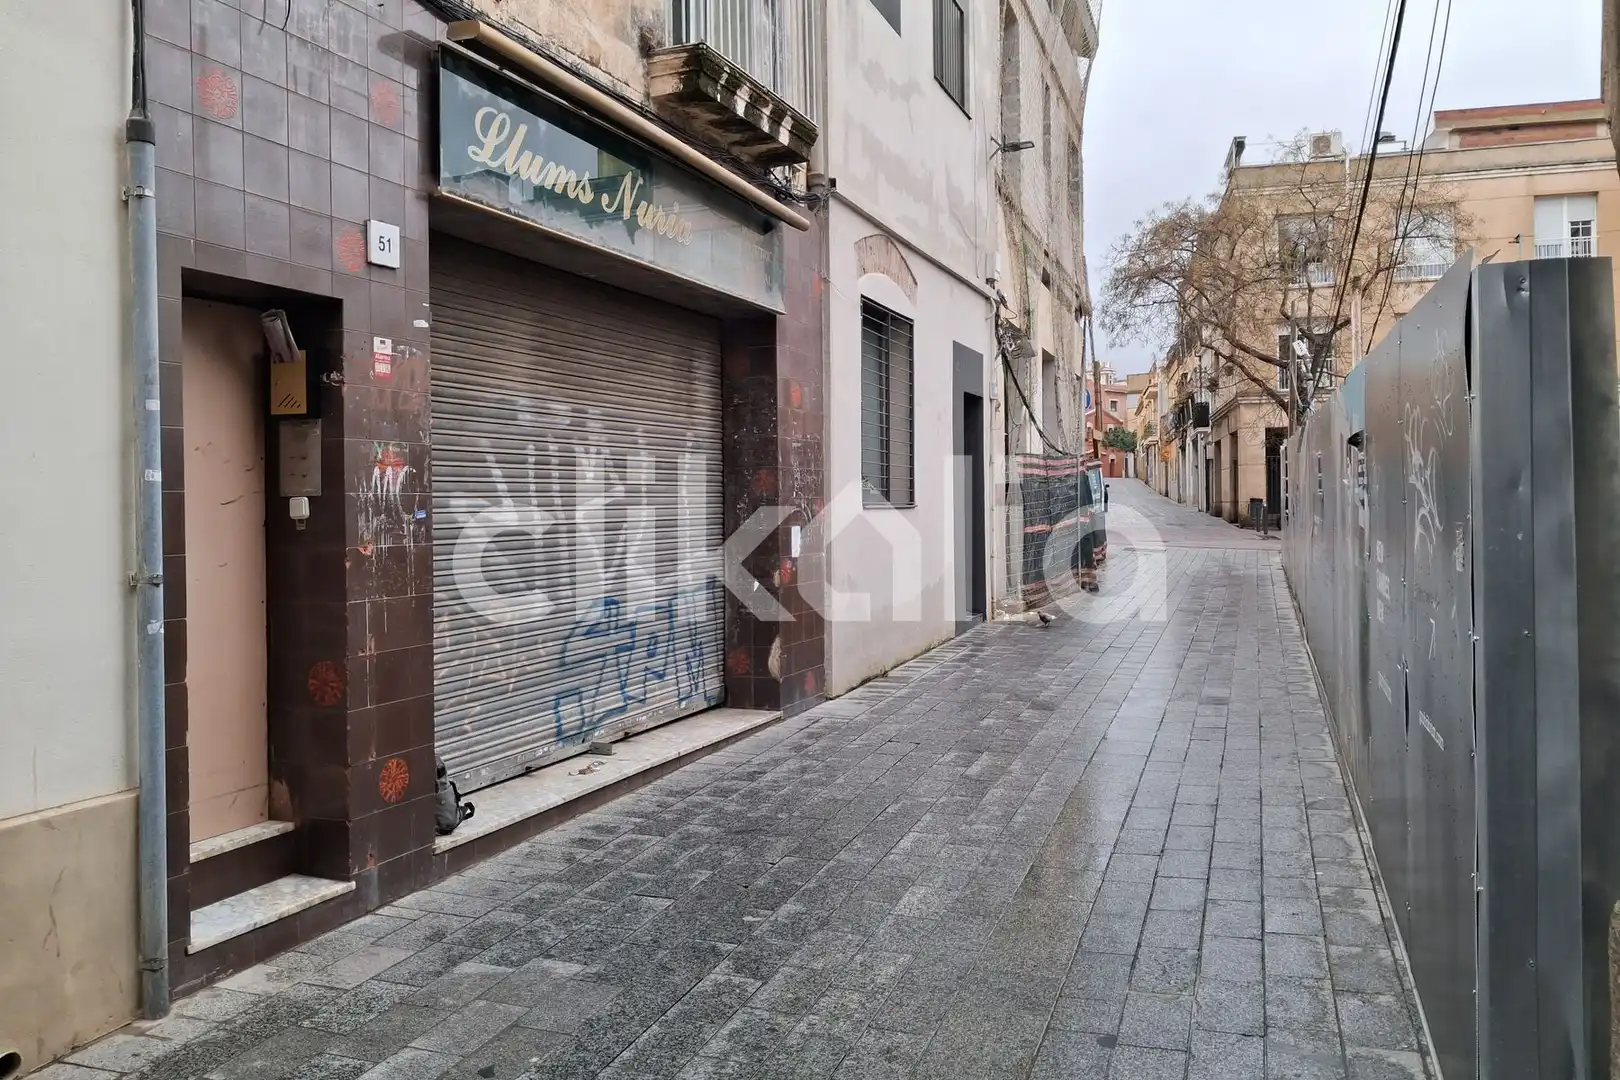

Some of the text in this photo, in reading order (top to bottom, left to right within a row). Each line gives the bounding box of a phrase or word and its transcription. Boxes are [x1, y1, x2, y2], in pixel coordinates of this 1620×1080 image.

[468, 107, 693, 245] Llums Nuria
[378, 235, 391, 253] 51
